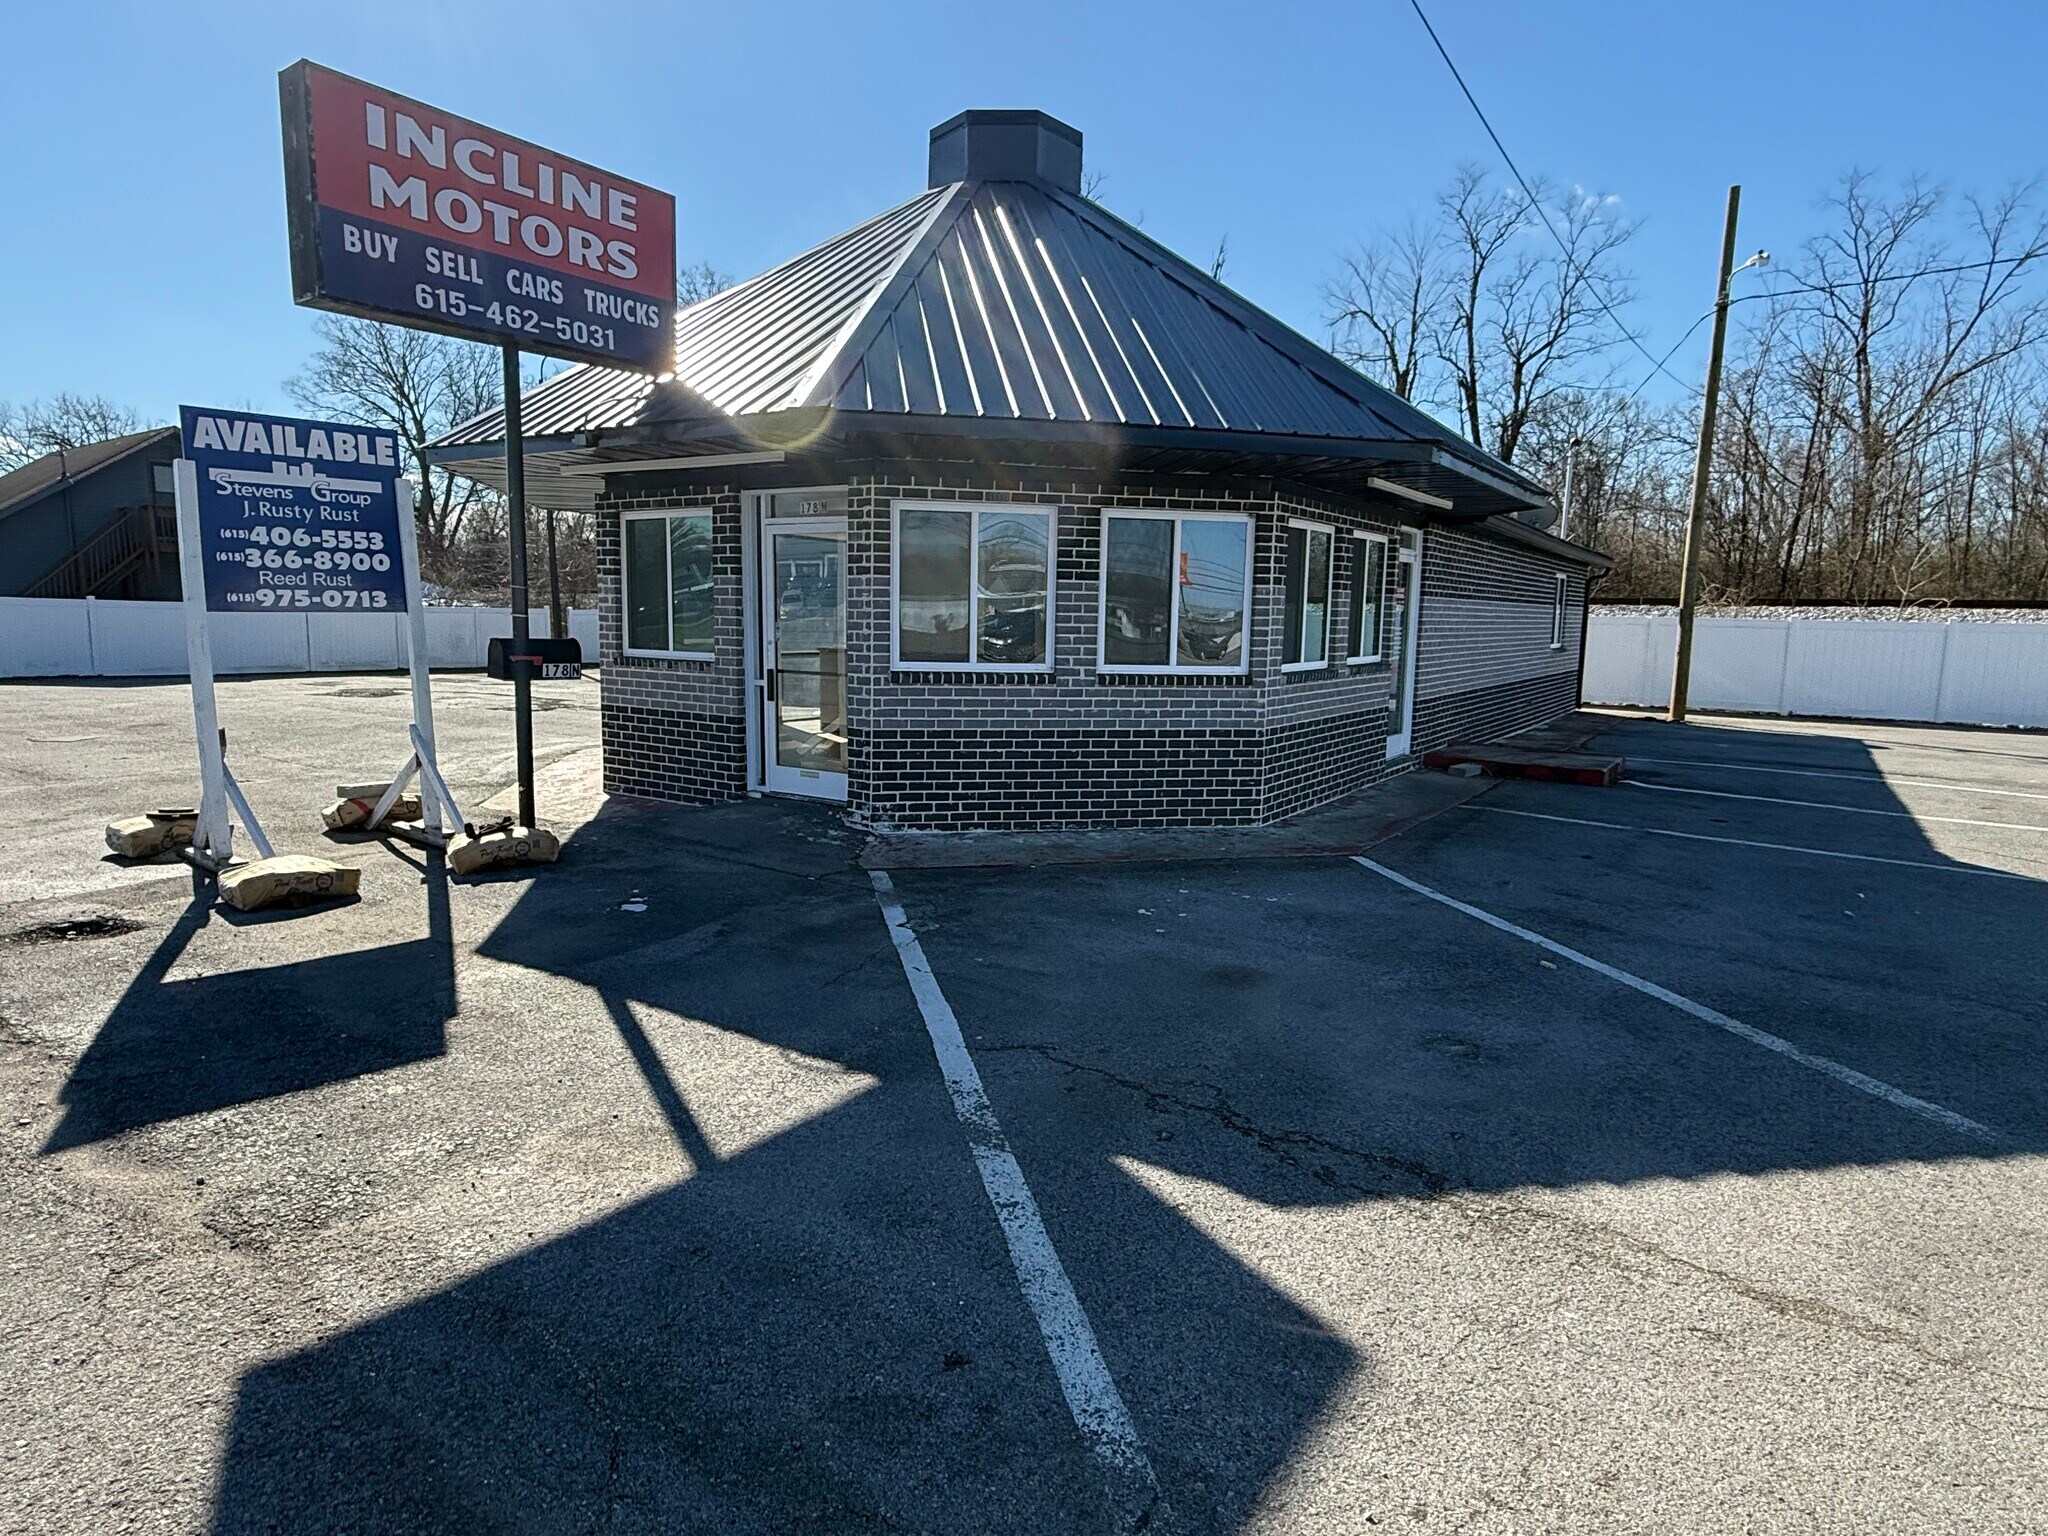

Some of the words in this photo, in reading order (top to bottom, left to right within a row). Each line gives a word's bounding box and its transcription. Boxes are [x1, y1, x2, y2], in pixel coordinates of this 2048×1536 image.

[365, 101, 638, 232] INCLINE
[368, 163, 638, 279] MOTORS
[343, 223, 398, 263] BUY
[425, 246, 484, 285] SELL
[506, 269, 564, 304] CARS
[584, 288, 660, 328] TRUCKS
[415, 283, 615, 351] 615-462-5031
[193, 416, 395, 467] AVAILABLE
[215, 472, 294, 500] Stevens
[311, 481, 371, 508] Group
[243, 501, 256, 518] J.
[259, 502, 314, 524] Rusty
[320, 505, 360, 523] Rust
[259, 571, 307, 586] Reed
[313, 572, 353, 587] Rust
